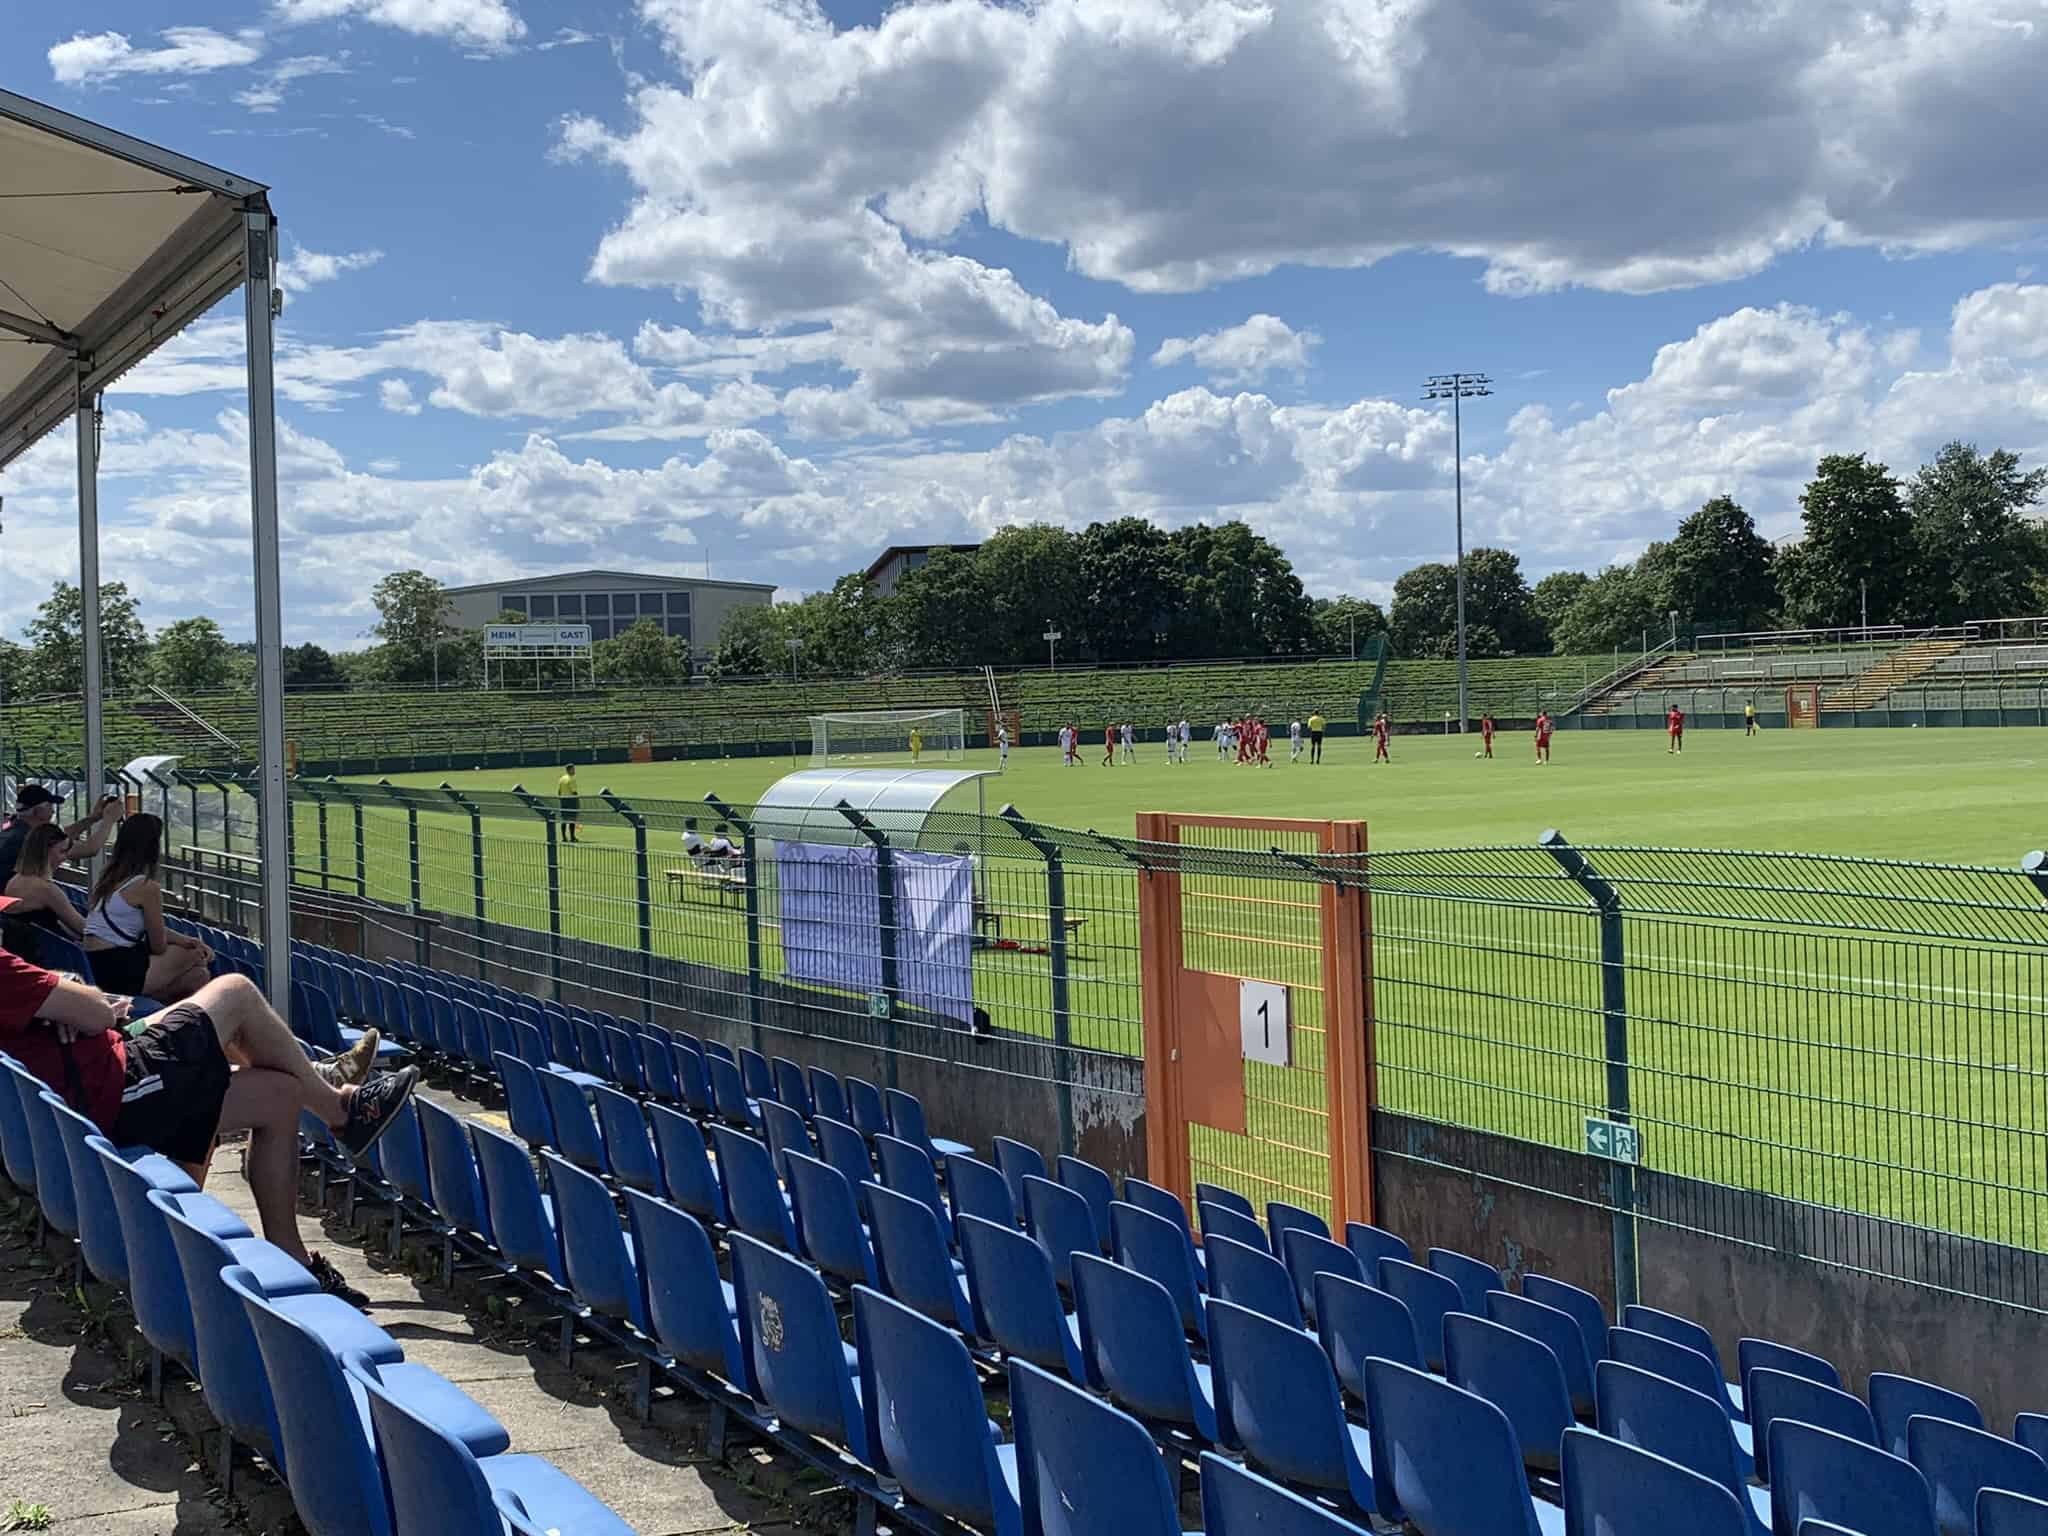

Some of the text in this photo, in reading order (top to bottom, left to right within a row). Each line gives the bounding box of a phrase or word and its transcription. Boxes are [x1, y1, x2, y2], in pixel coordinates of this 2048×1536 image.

[491, 631, 585, 640] HEIM GAST
[1257, 999, 1269, 1049] 1
